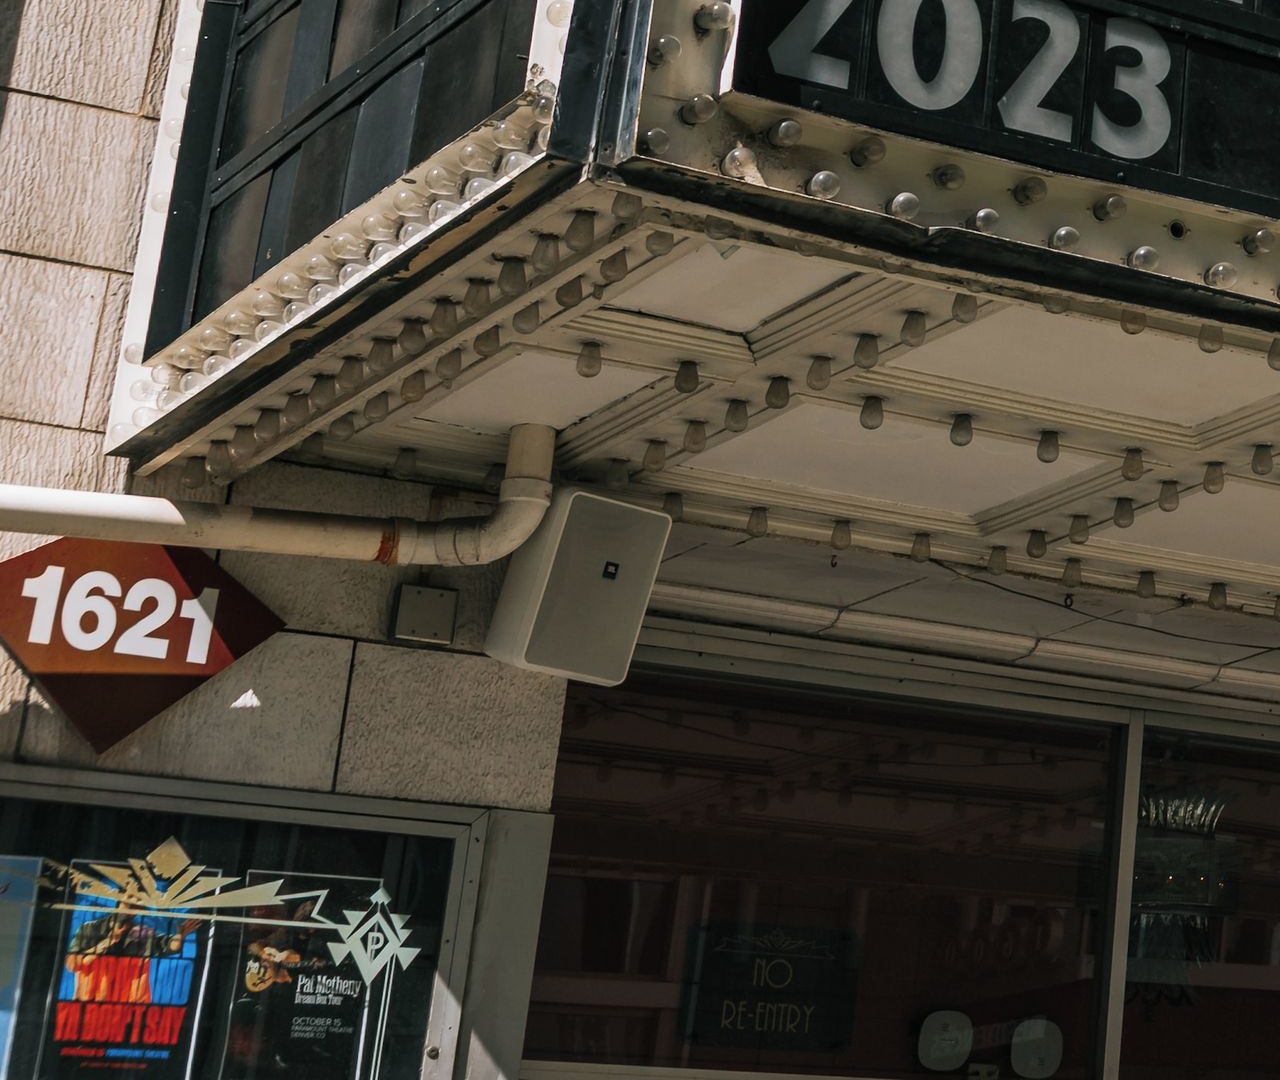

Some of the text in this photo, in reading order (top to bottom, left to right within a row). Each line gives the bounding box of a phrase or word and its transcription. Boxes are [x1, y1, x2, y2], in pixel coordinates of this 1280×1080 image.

[21, 565, 220, 665] 1621
[295, 974, 362, 998] Pat Metheny
[752, 958, 793, 990] NO
[143, 1005, 188, 1045] SAY
[292, 1016, 332, 1027] OCTOBER
[720, 1000, 817, 1034] RE-ENTRY
